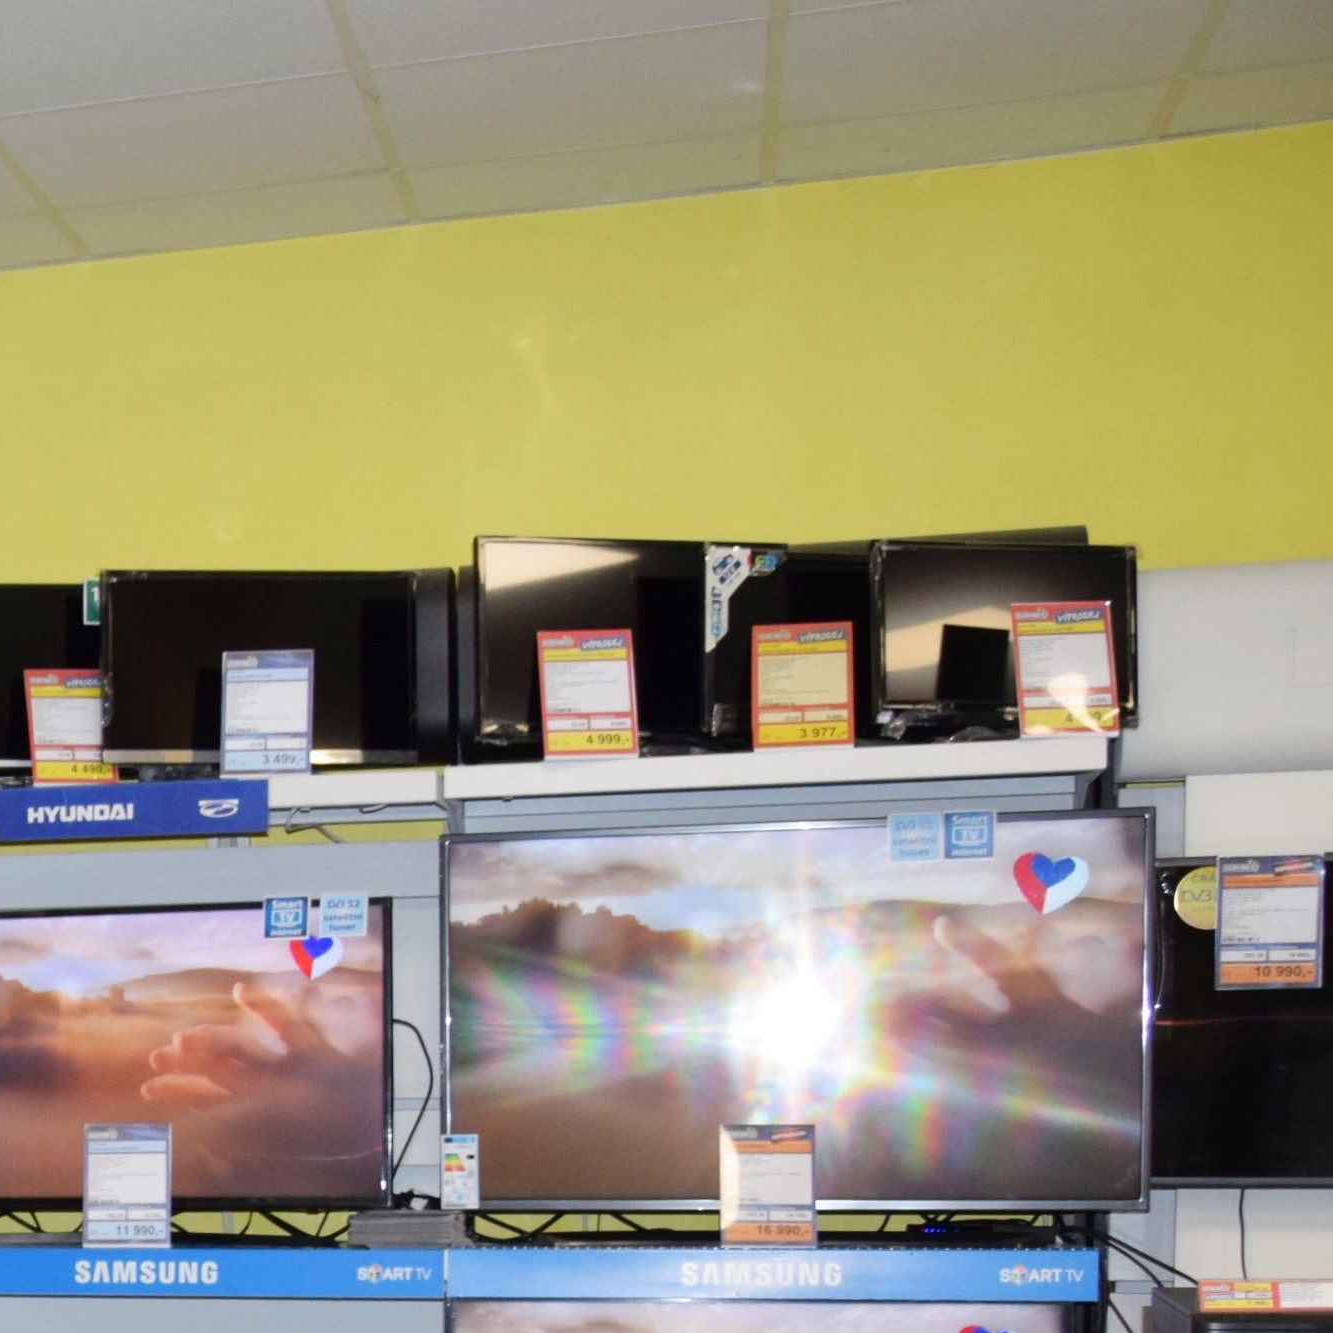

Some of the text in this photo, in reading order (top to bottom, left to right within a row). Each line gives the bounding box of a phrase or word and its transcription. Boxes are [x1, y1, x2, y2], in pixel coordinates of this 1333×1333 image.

[597, 733, 631, 746] 999,-
[810, 727, 846, 740] 977,-
[27, 803, 134, 824] HYUNDAI
[952, 815, 987, 826] Smart
[960, 830, 980, 840] TV
[271, 900, 303, 910] Smart
[116, 1224, 165, 1238] 11 990,-
[74, 1261, 219, 1284] SAMSUNG
[416, 1267, 432, 1279] TV
[680, 1262, 843, 1287] SAMSUNG
[1065, 1268, 1084, 1282] TV
